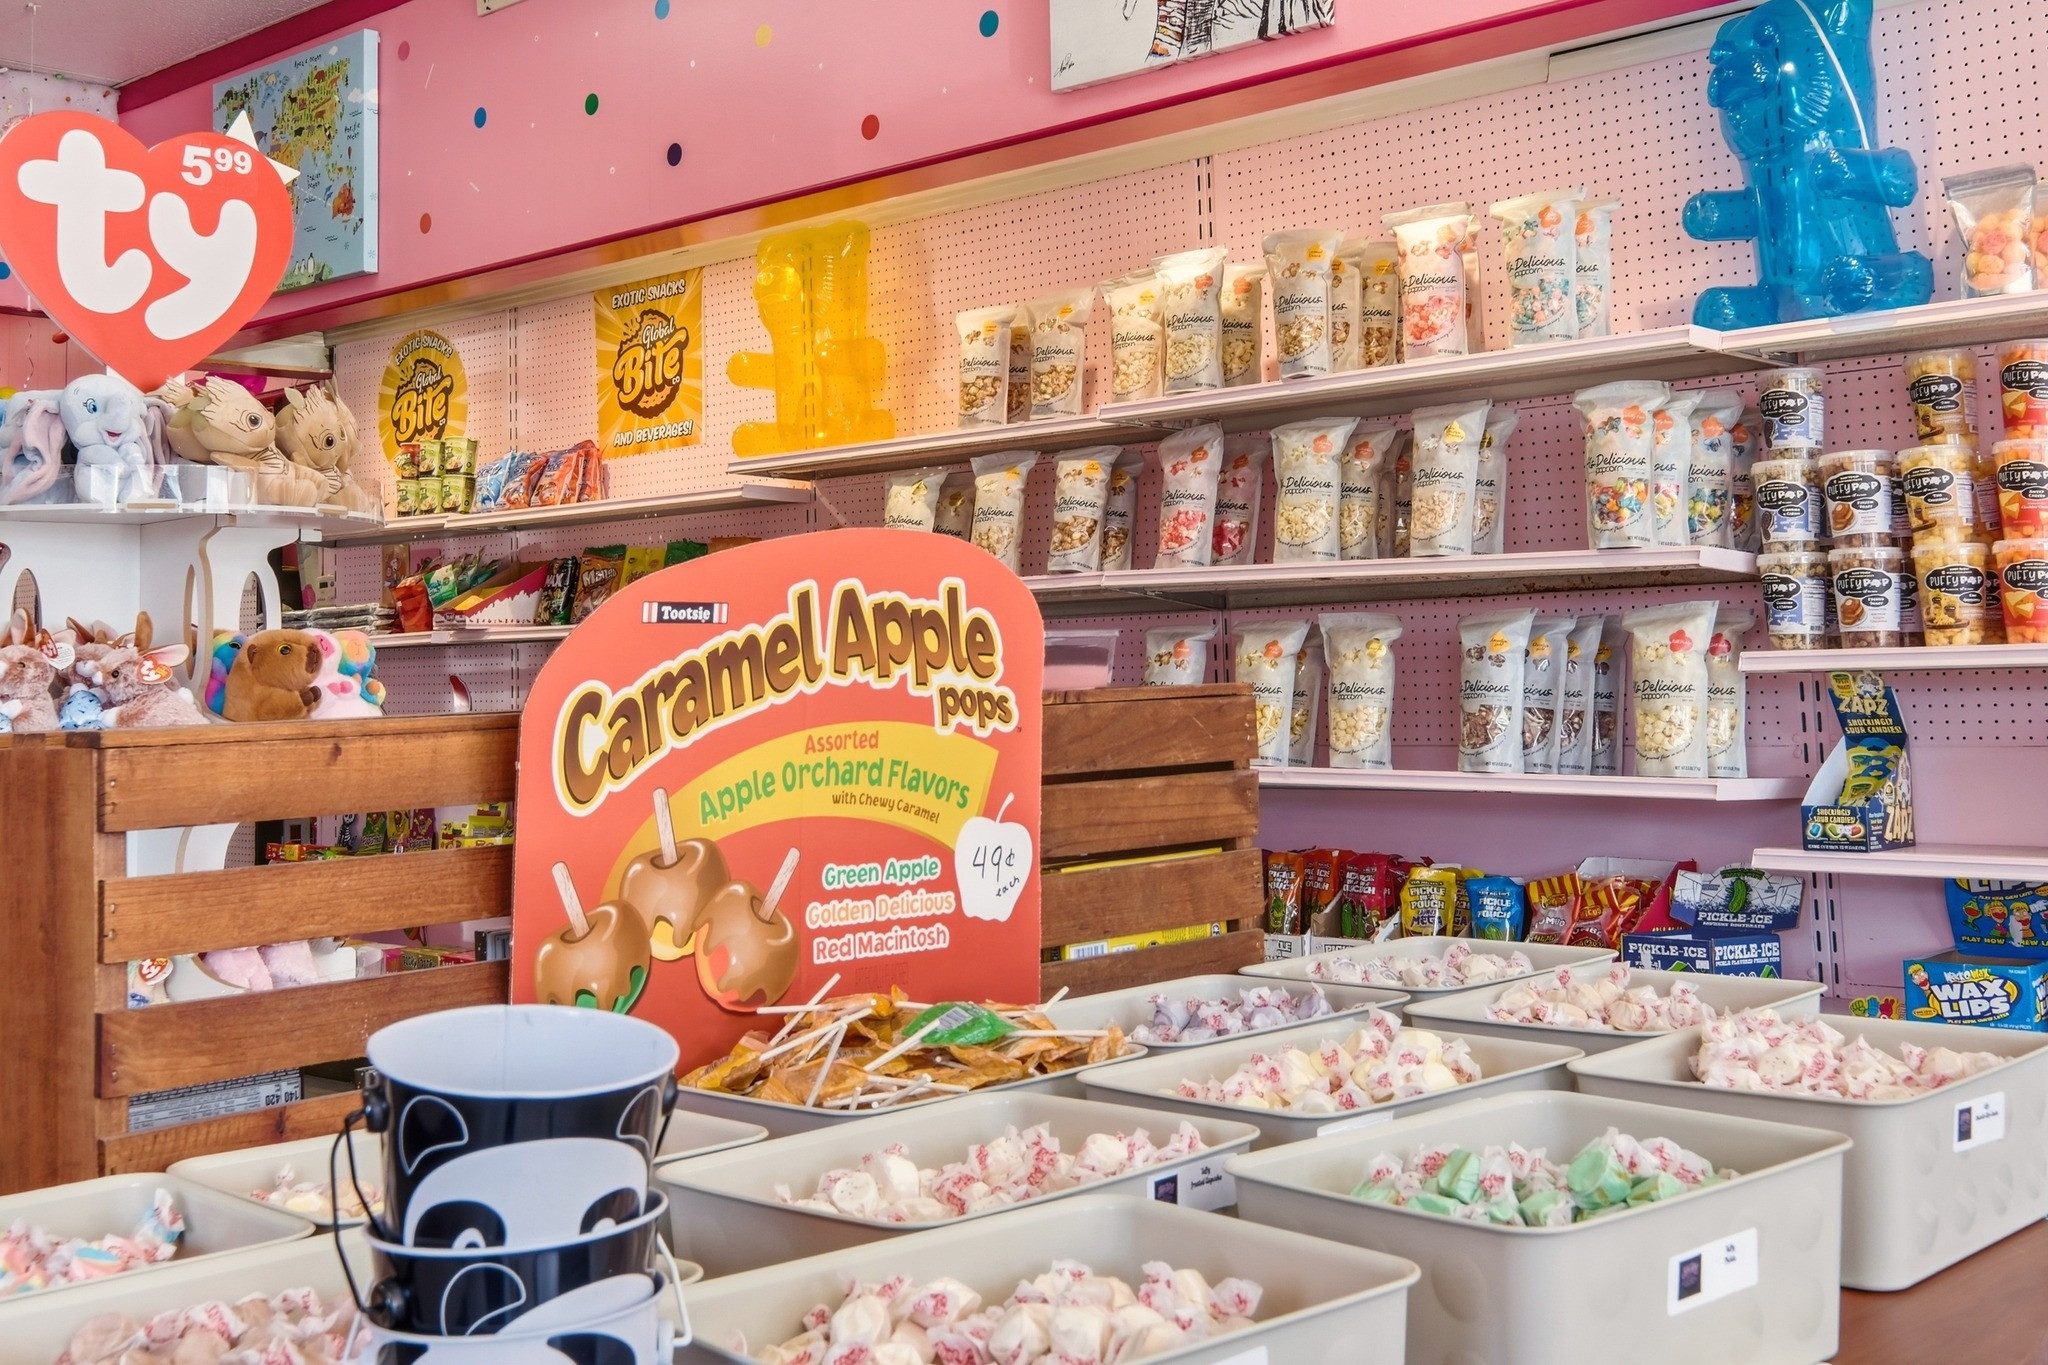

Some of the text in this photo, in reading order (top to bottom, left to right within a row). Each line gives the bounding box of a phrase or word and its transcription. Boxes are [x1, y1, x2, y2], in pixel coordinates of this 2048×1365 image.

[18, 129, 257, 340] ty
[1515, 255, 1566, 271] Delicious
[1409, 273, 1458, 285] Delicious
[612, 279, 686, 310] EXOTIC SNACKS
[1278, 294, 1323, 306] Delicious
[1172, 313, 1215, 324] Delicious
[642, 317, 675, 348] Global
[1115, 332, 1156, 343] Delicious
[395, 335, 454, 366] EXOTIC SNACKS
[1036, 345, 1076, 357] Delicious
[614, 327, 689, 404] Bite
[415, 366, 442, 391] Global
[391, 376, 453, 443] Bite
[613, 419, 694, 448] AND BEVERAGES!
[1596, 452, 1648, 468] Delicious
[1418, 467, 1465, 481] Delicious
[1688, 464, 1727, 476] licious
[1287, 476, 1334, 489] Delicious
[1058, 496, 1099, 509] Delicious
[977, 505, 1015, 518] Delicious
[1930, 576, 1959, 587] PUFFY
[2007, 570, 2036, 581] PUFFY
[662, 606, 711, 622] Tootsie
[1339, 682, 1386, 694] Delicious
[1464, 680, 1511, 693] Delicious
[1641, 679, 1696, 693] Delicious
[563, 586, 998, 806] Caramel Apple
[938, 685, 1014, 729] pops
[1838, 694, 1889, 717] ZAPZ
[1847, 718, 1893, 727] SHOCKINGLY
[1867, 726, 1903, 734] CANDIES!
[804, 730, 879, 755] Assorted
[700, 756, 970, 825] Apple Orchard Flavors
[832, 791, 941, 824] with Chewy Caramel
[824, 857, 939, 887] Green Apple
[972, 845, 1016, 883] 49¢
[995, 876, 1020, 898] each
[1410, 887, 1446, 896] PICKLE
[808, 892, 953, 927] Golden Delicious
[1410, 900, 1445, 909] POUCH
[1697, 911, 1773, 924] PICKLE-ICE
[815, 925, 948, 962] Red Macintosh
[1628, 942, 1707, 958] PICKLE-ICE
[1714, 942, 1780, 961] PICKLE-ICE
[141, 958, 162, 979] ty
[1930, 979, 2008, 1001] WAX
[1941, 996, 2011, 1018] LIPS
